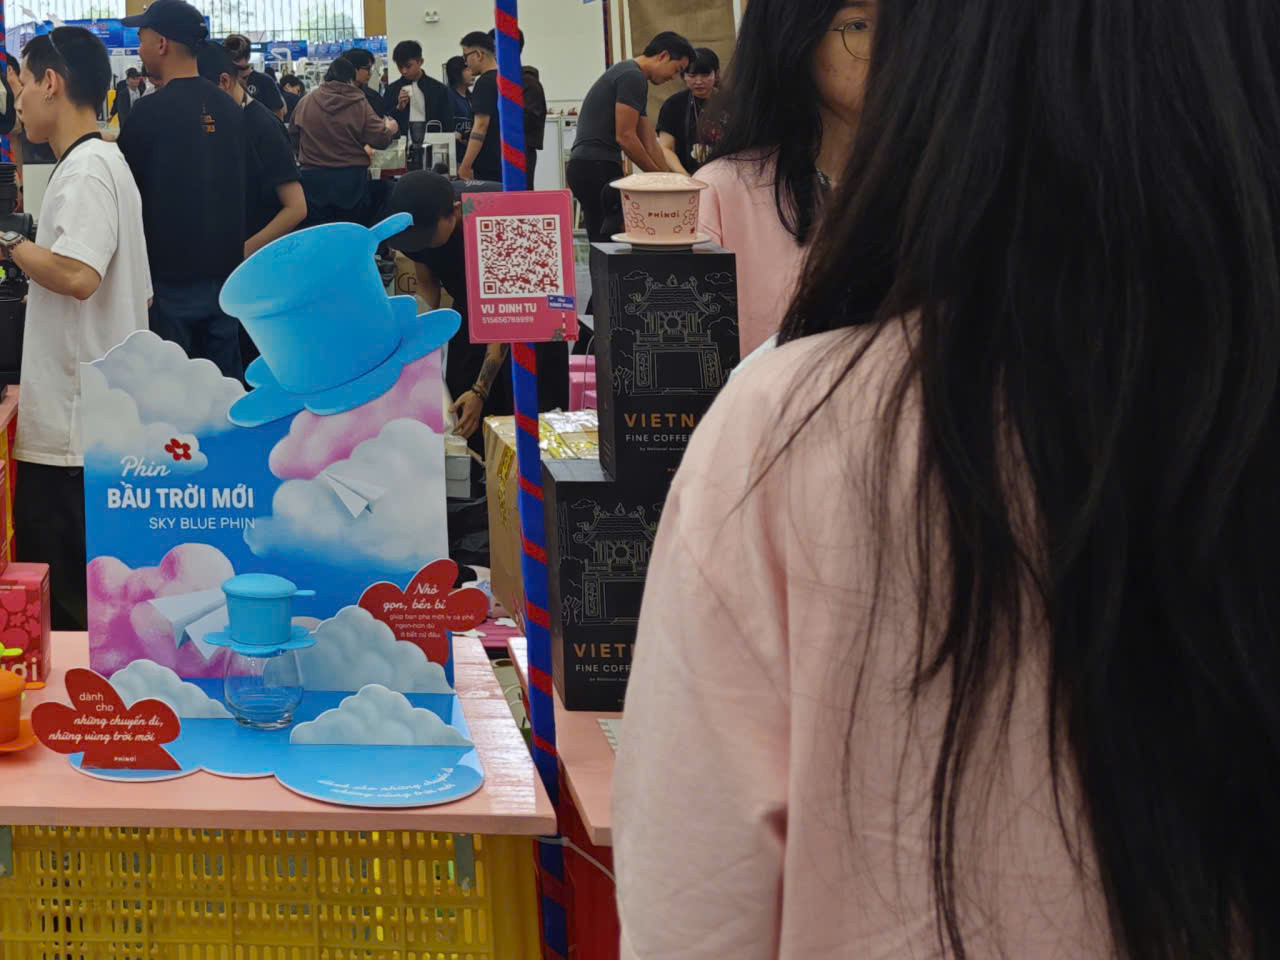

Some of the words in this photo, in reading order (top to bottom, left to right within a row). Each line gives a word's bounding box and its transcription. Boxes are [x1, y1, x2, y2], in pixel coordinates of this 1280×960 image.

[481, 304, 495, 314] VU
[498, 303, 523, 314] DINH
[524, 302, 537, 313] TU
[624, 413, 695, 428] VIETN
[625, 434, 649, 442] FINE
[120, 455, 171, 477] Phin
[107, 480, 151, 509] BẦU
[156, 483, 206, 509] TRỜI
[212, 483, 254, 509] MỚI
[149, 517, 176, 529] SKY
[180, 517, 216, 529] BLUE
[221, 517, 256, 529] PHIN
[413, 583, 440, 595] Nhỏ
[573, 643, 636, 658] VIET
[576, 664, 599, 672] FINE
[603, 664, 632, 672] COFF
[79, 692, 104, 701] dành
[96, 703, 114, 711] cho
[73, 714, 108, 729] những
[109, 714, 147, 730] chuyến
[48, 730, 82, 744] những
[84, 732, 112, 744] vùng
[113, 730, 134, 741] trời
[135, 730, 156, 741] mới
